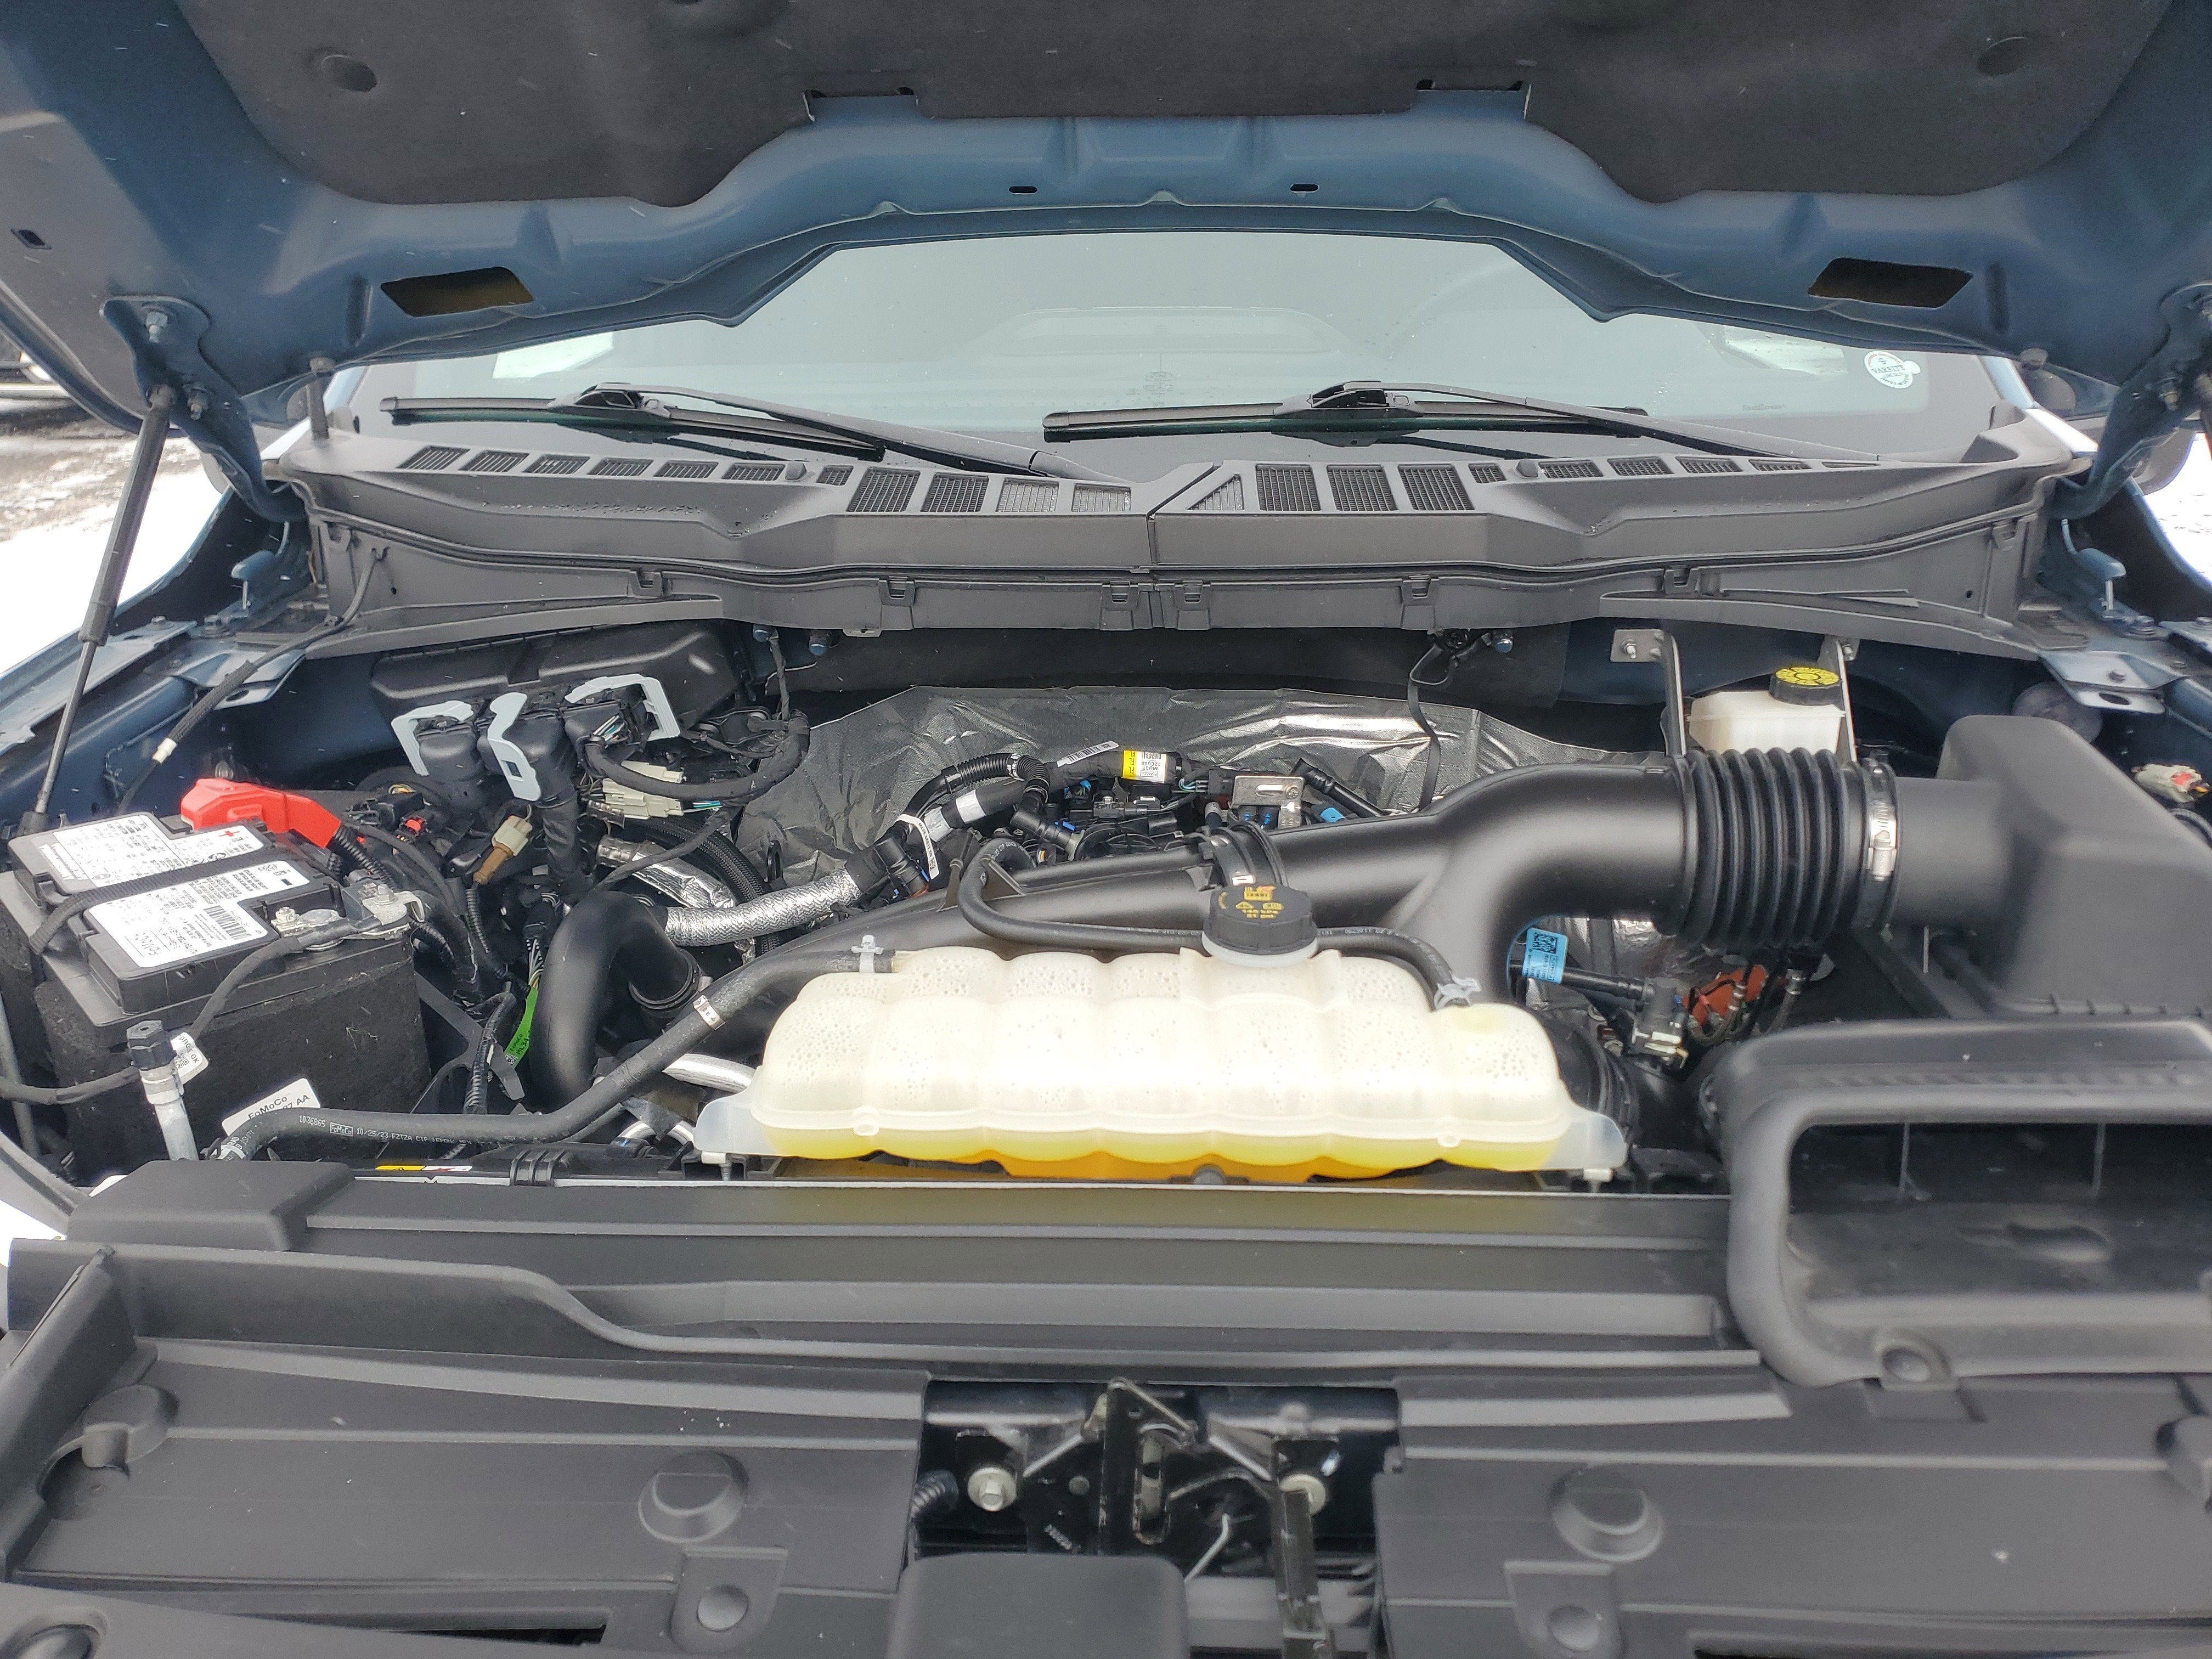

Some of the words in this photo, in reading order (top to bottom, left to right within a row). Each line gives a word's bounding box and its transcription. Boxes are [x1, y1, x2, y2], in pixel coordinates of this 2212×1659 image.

[1871, 365, 1905, 374] VARSITY
[136, 932, 160, 956] FoMoCo
[190, 1054, 200, 1064] OK
[248, 1096, 287, 1119] FoMoCo
[297, 1094, 310, 1106] AA
[299, 1115, 326, 1127] 1036865
[331, 1124, 352, 1135] FoMoCo
[357, 1127, 388, 1138] 10/25/23
